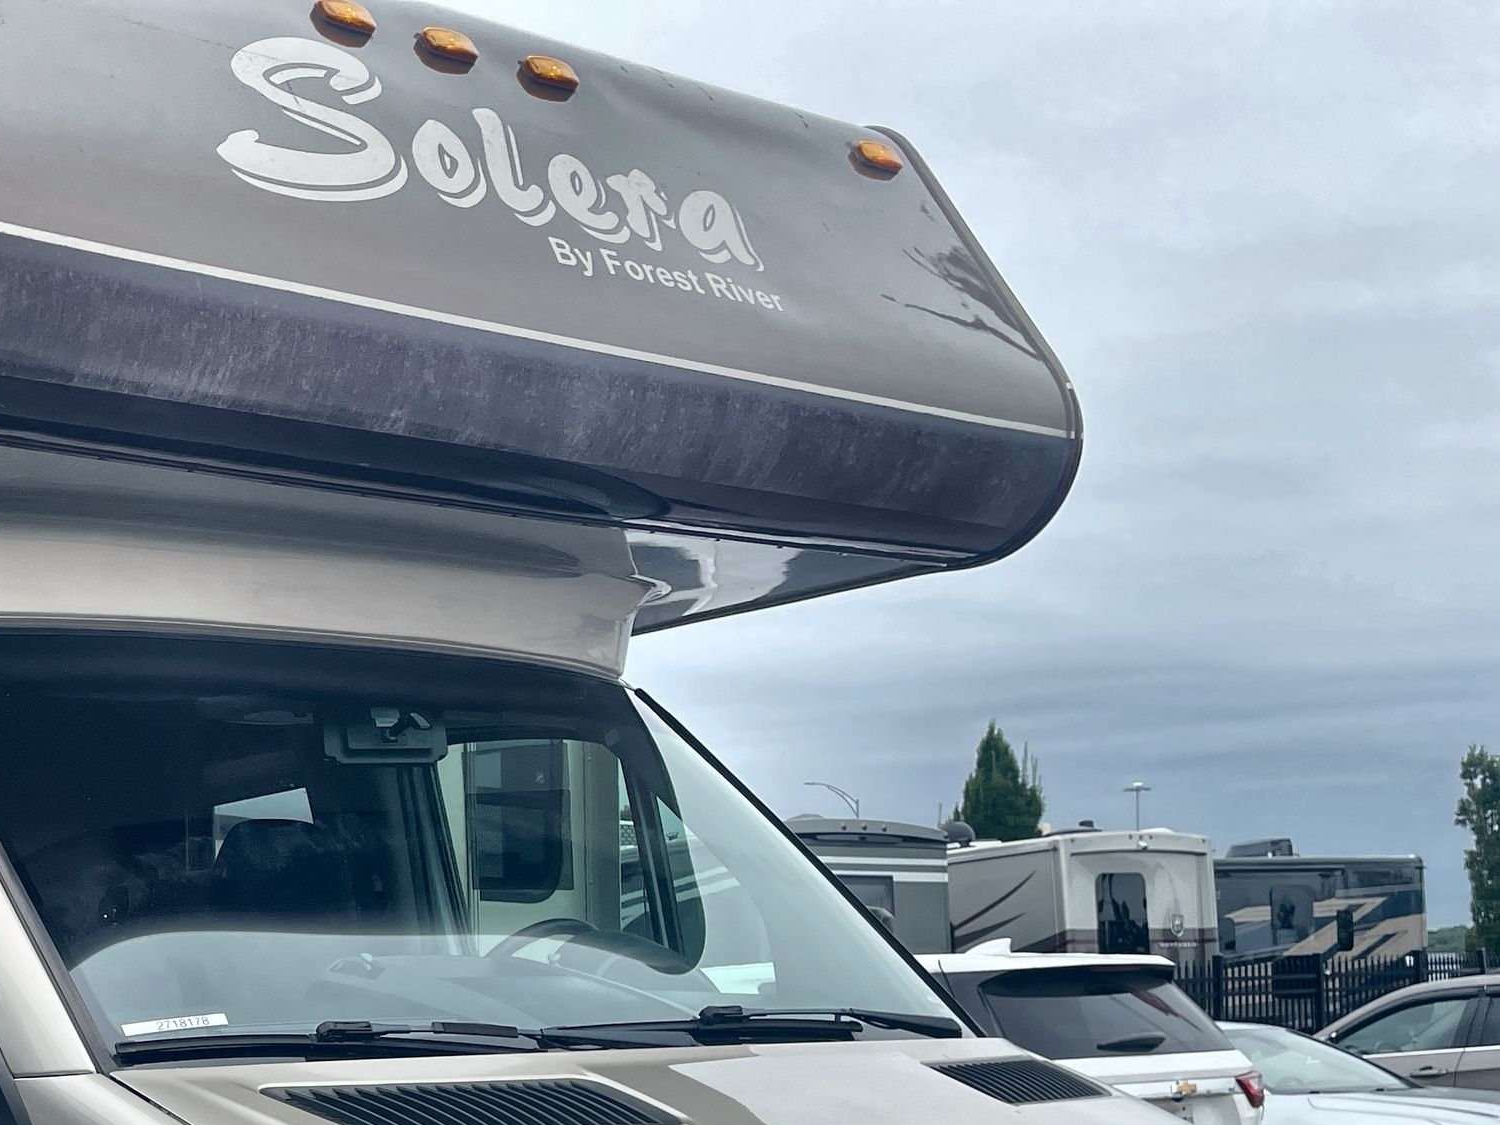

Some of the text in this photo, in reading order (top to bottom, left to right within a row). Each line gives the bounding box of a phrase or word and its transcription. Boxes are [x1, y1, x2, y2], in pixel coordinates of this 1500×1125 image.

[216, 36, 765, 272] Solera
[548, 235, 785, 311] By Forest River
[156, 1016, 210, 1031] 2718178
